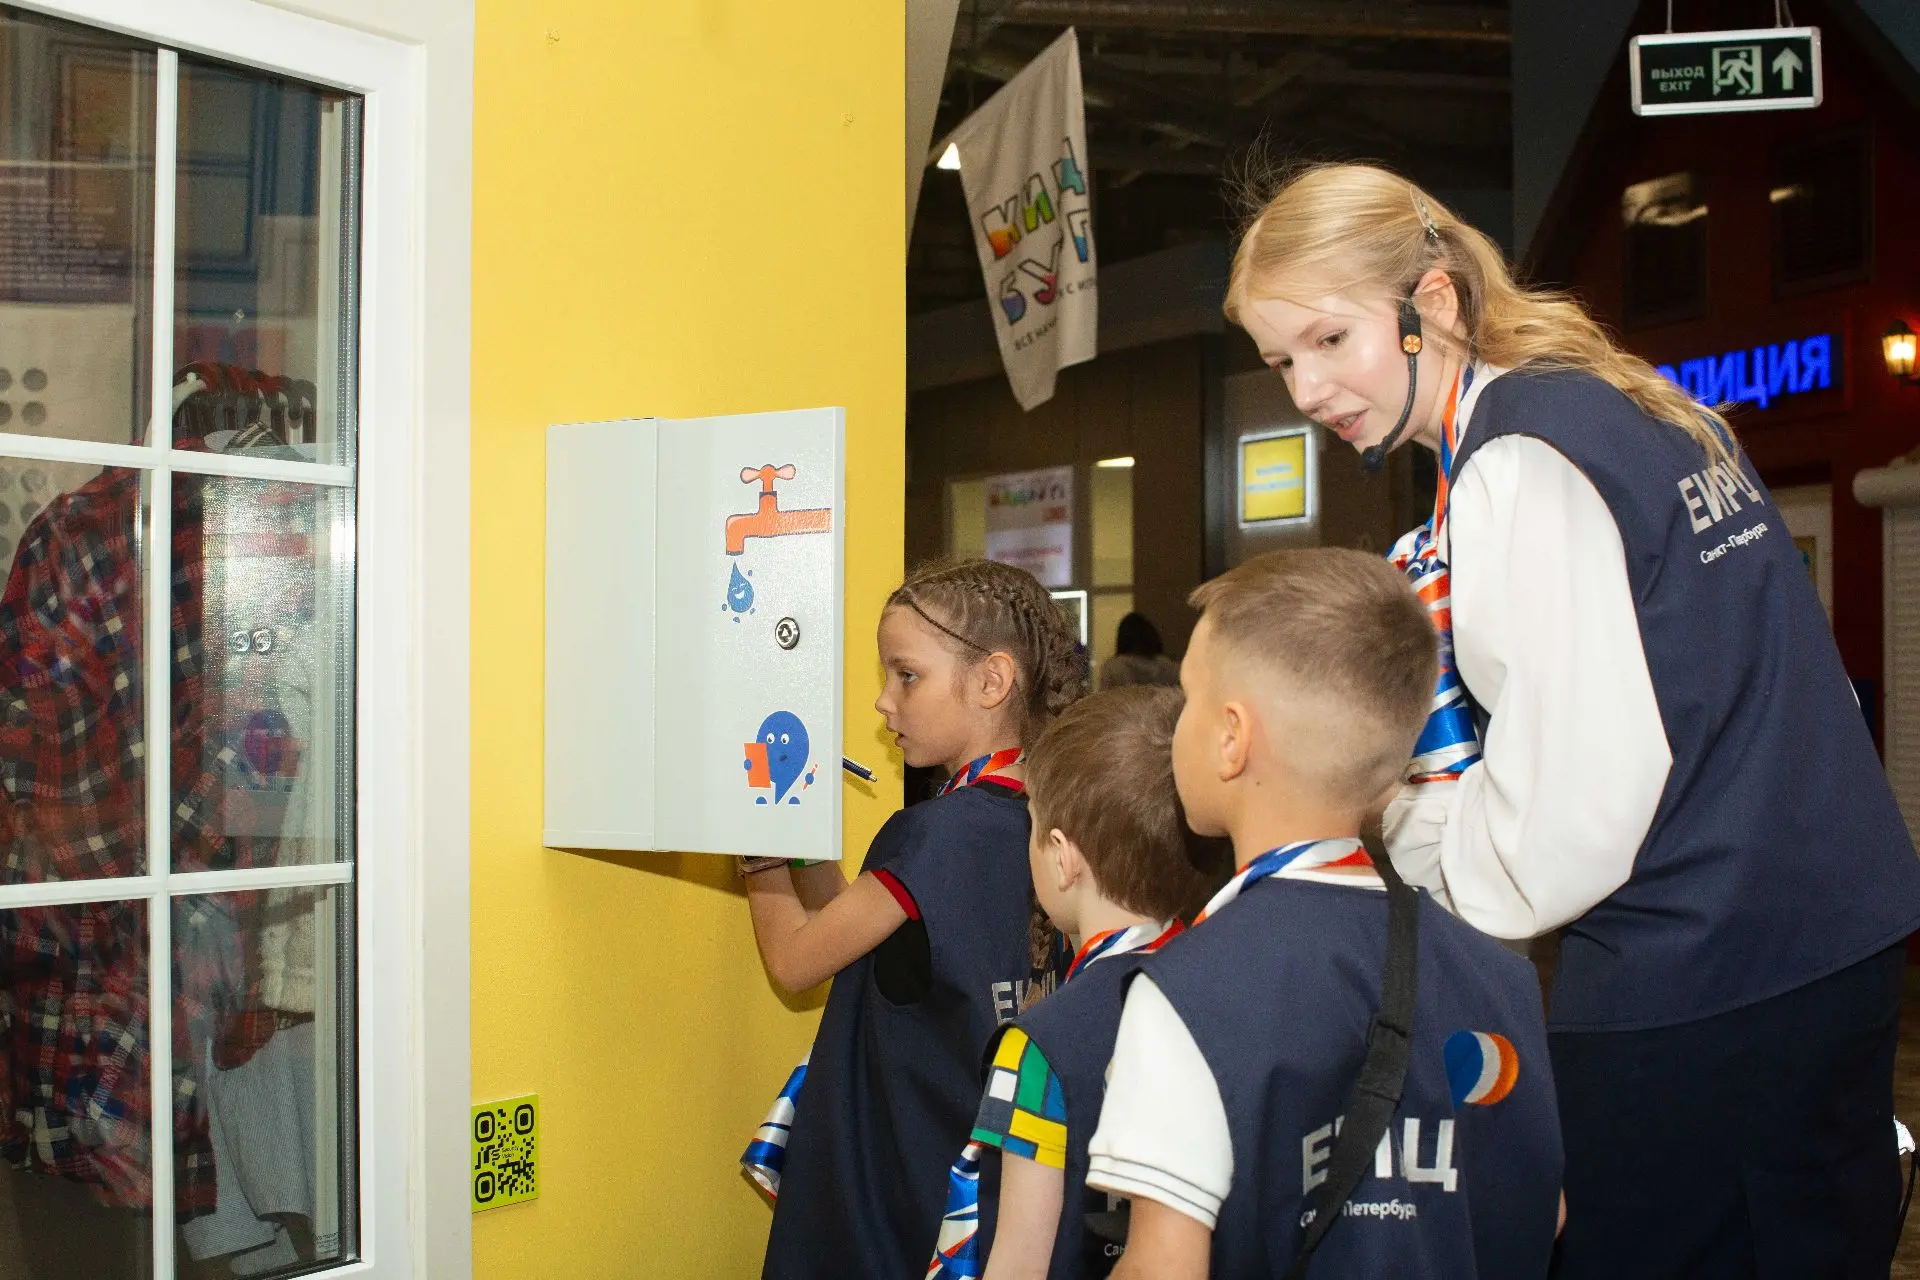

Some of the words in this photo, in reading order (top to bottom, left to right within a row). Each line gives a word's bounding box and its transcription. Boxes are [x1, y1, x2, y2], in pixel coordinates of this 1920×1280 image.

[1651, 66, 1705, 80] ВЫХОД
[1660, 80, 1692, 93] EXIT
[1677, 461, 1765, 534] ЕИРЦ
